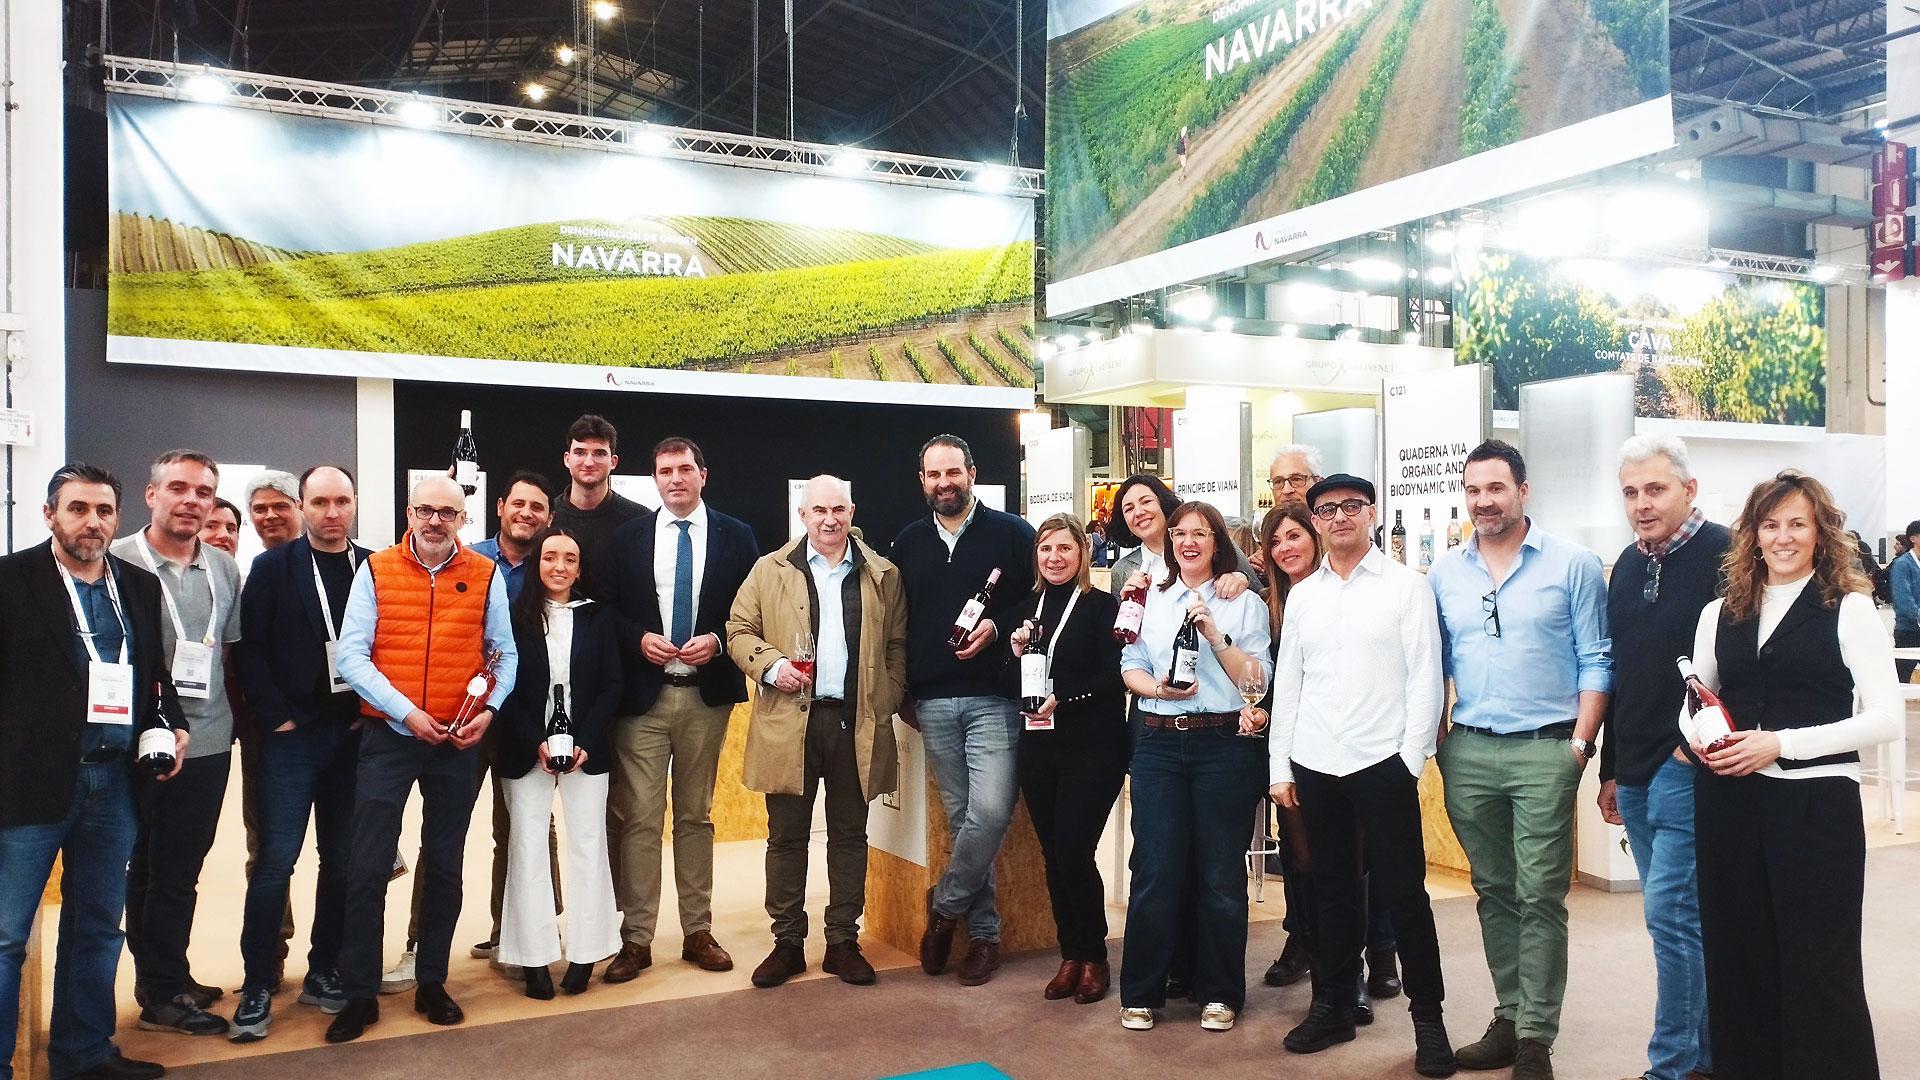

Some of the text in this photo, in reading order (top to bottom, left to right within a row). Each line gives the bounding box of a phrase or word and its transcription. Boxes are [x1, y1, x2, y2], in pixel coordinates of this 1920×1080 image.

[560, 225, 698, 246] DENOMINACIÓN DE ORIGEN
[1274, 230, 1308, 246] NAVARRA
[552, 242, 706, 278] NAVARRA
[1629, 331, 1673, 352] CAVA
[1594, 349, 1635, 362] COMTATS
[1638, 353, 1650, 363] DE
[1305, 360, 1336, 370] GRUPO
[1390, 386, 1406, 397] C121
[1399, 442, 1467, 461] QUADERNA VIA
[1402, 461, 1465, 478] ORGANIC AND
[1207, 481, 1216, 492] DE
[1217, 479, 1238, 491] VIANA
[1390, 479, 1465, 497] BIODYNAMIC WIN
[1030, 491, 1073, 504] BODEGA DE SADA
